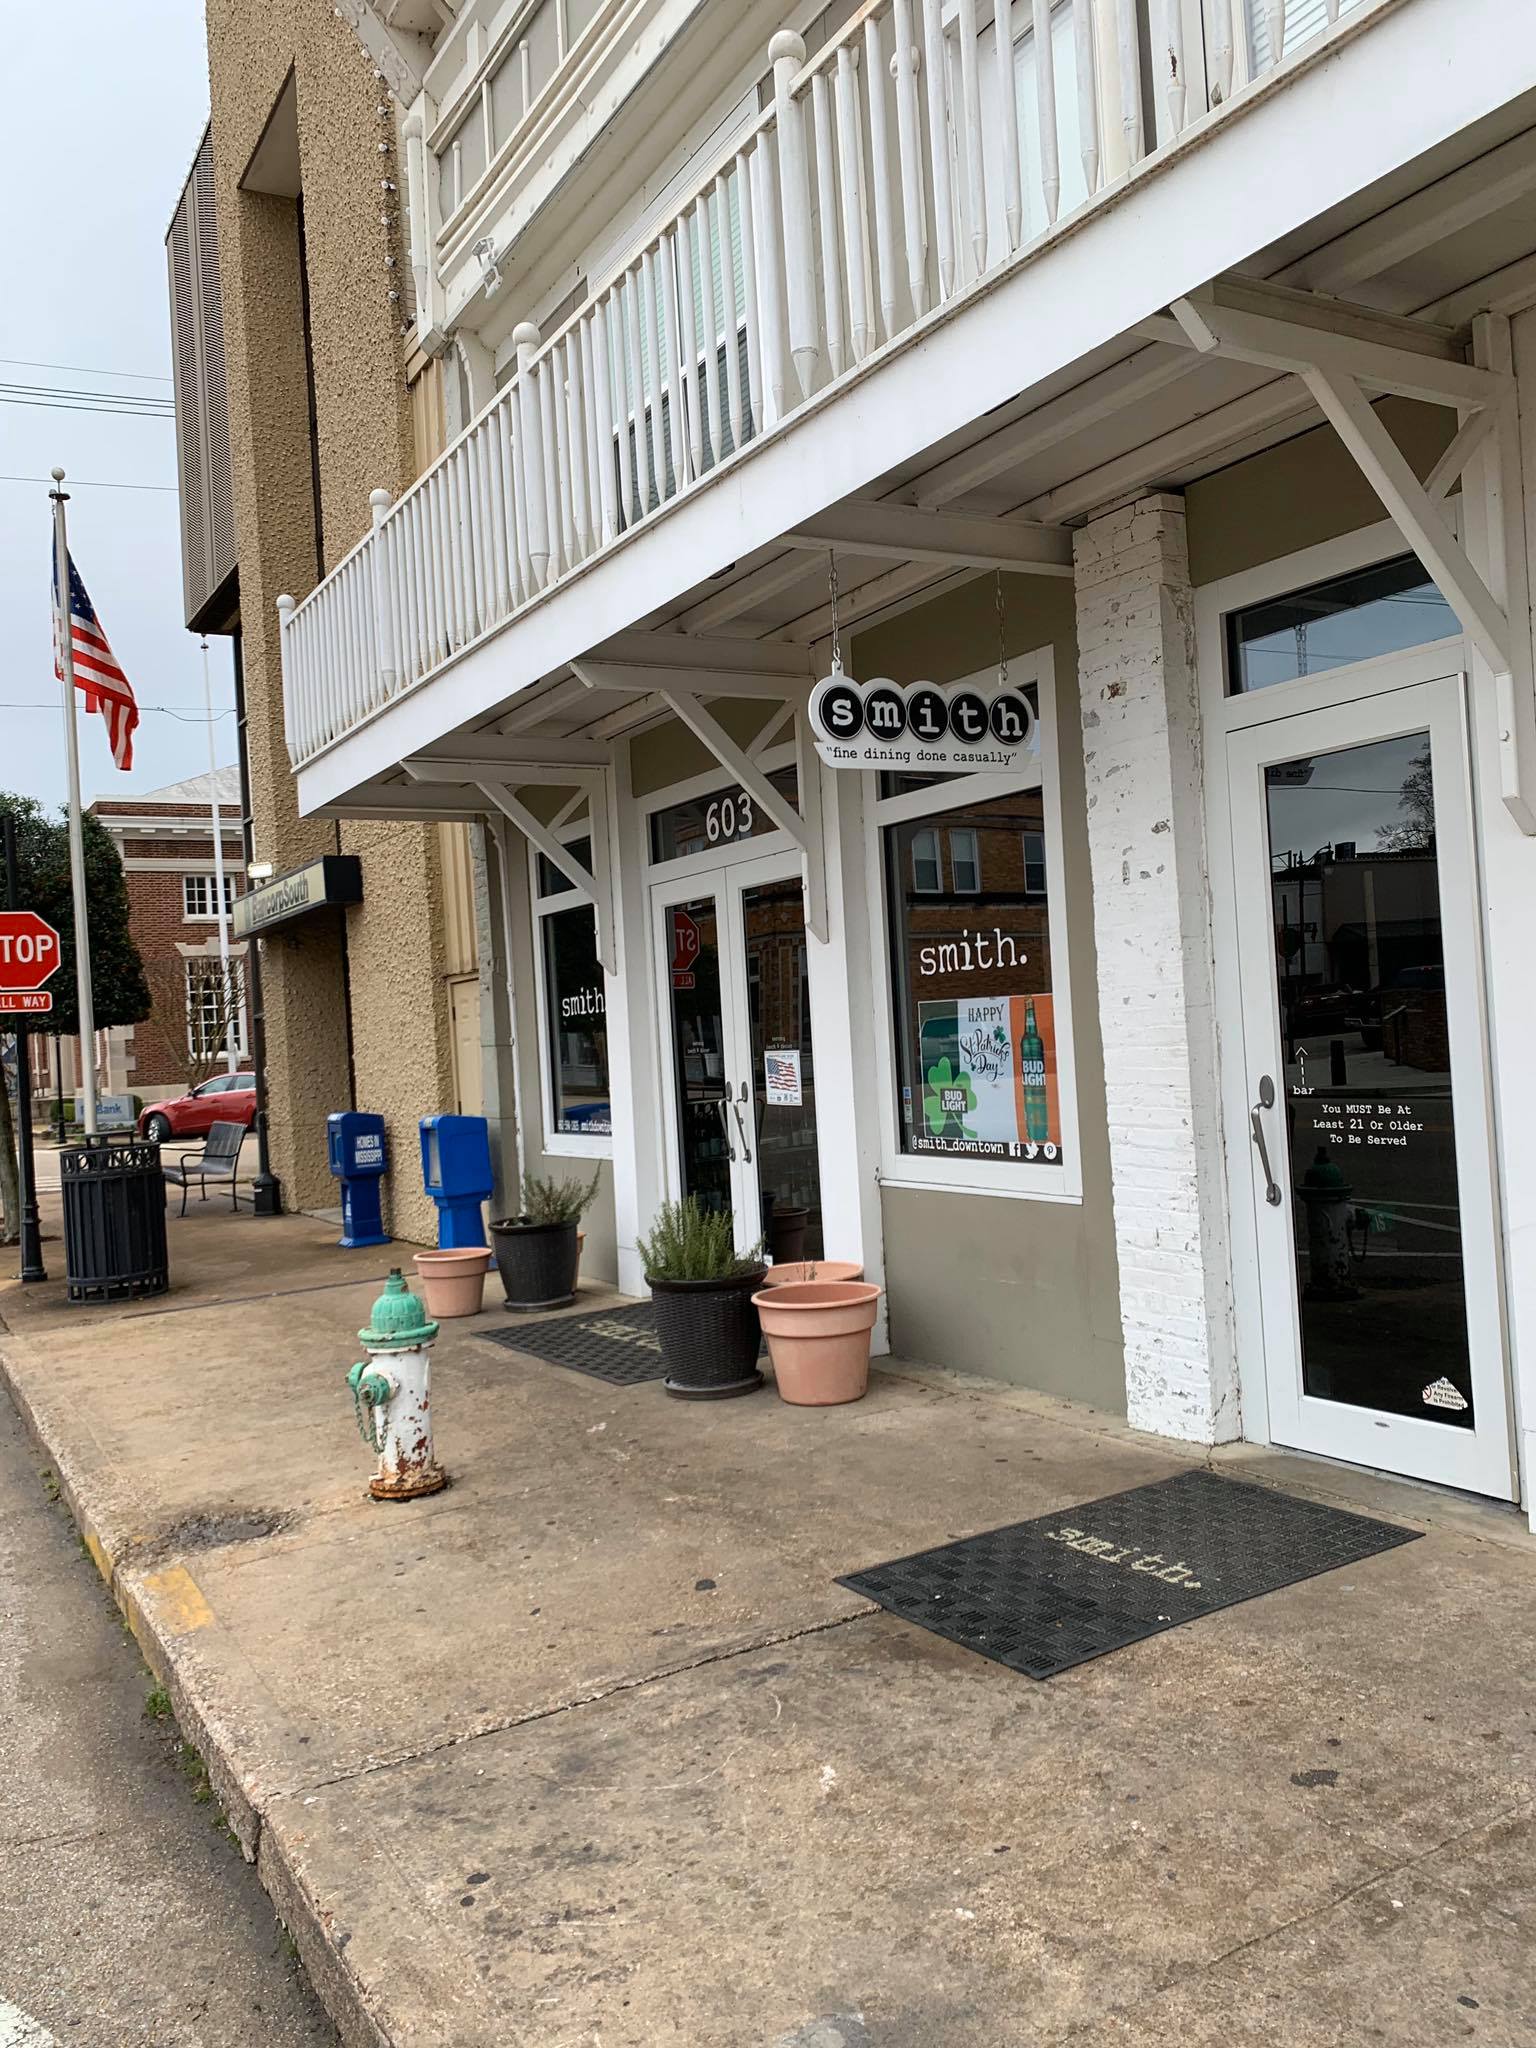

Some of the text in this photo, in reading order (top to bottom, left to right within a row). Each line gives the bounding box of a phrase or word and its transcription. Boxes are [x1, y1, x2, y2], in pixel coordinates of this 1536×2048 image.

[831, 698, 1024, 737] smith
[864, 748, 911, 764] dining
[916, 750, 947, 761] done
[706, 792, 753, 842] 603
[0, 934, 54, 963] TOP
[920, 927, 1028, 976] smith.
[0, 996, 46, 1008] LL WAY
[968, 1003, 1005, 1023] HAPPY
[975, 1054, 1004, 1082] Day
[1022, 1060, 1044, 1073] BUD
[944, 1090, 963, 1101] BUD
[1293, 1085, 1315, 1095] bar
[941, 1100, 967, 1112] LIGHT
[1322, 1104, 1411, 1114] You MUST Be At
[1313, 1118, 1423, 1131] Least 21 Or Older
[912, 1135, 1004, 1154] @smith_downtown
[1330, 1134, 1407, 1145] To Be Served
